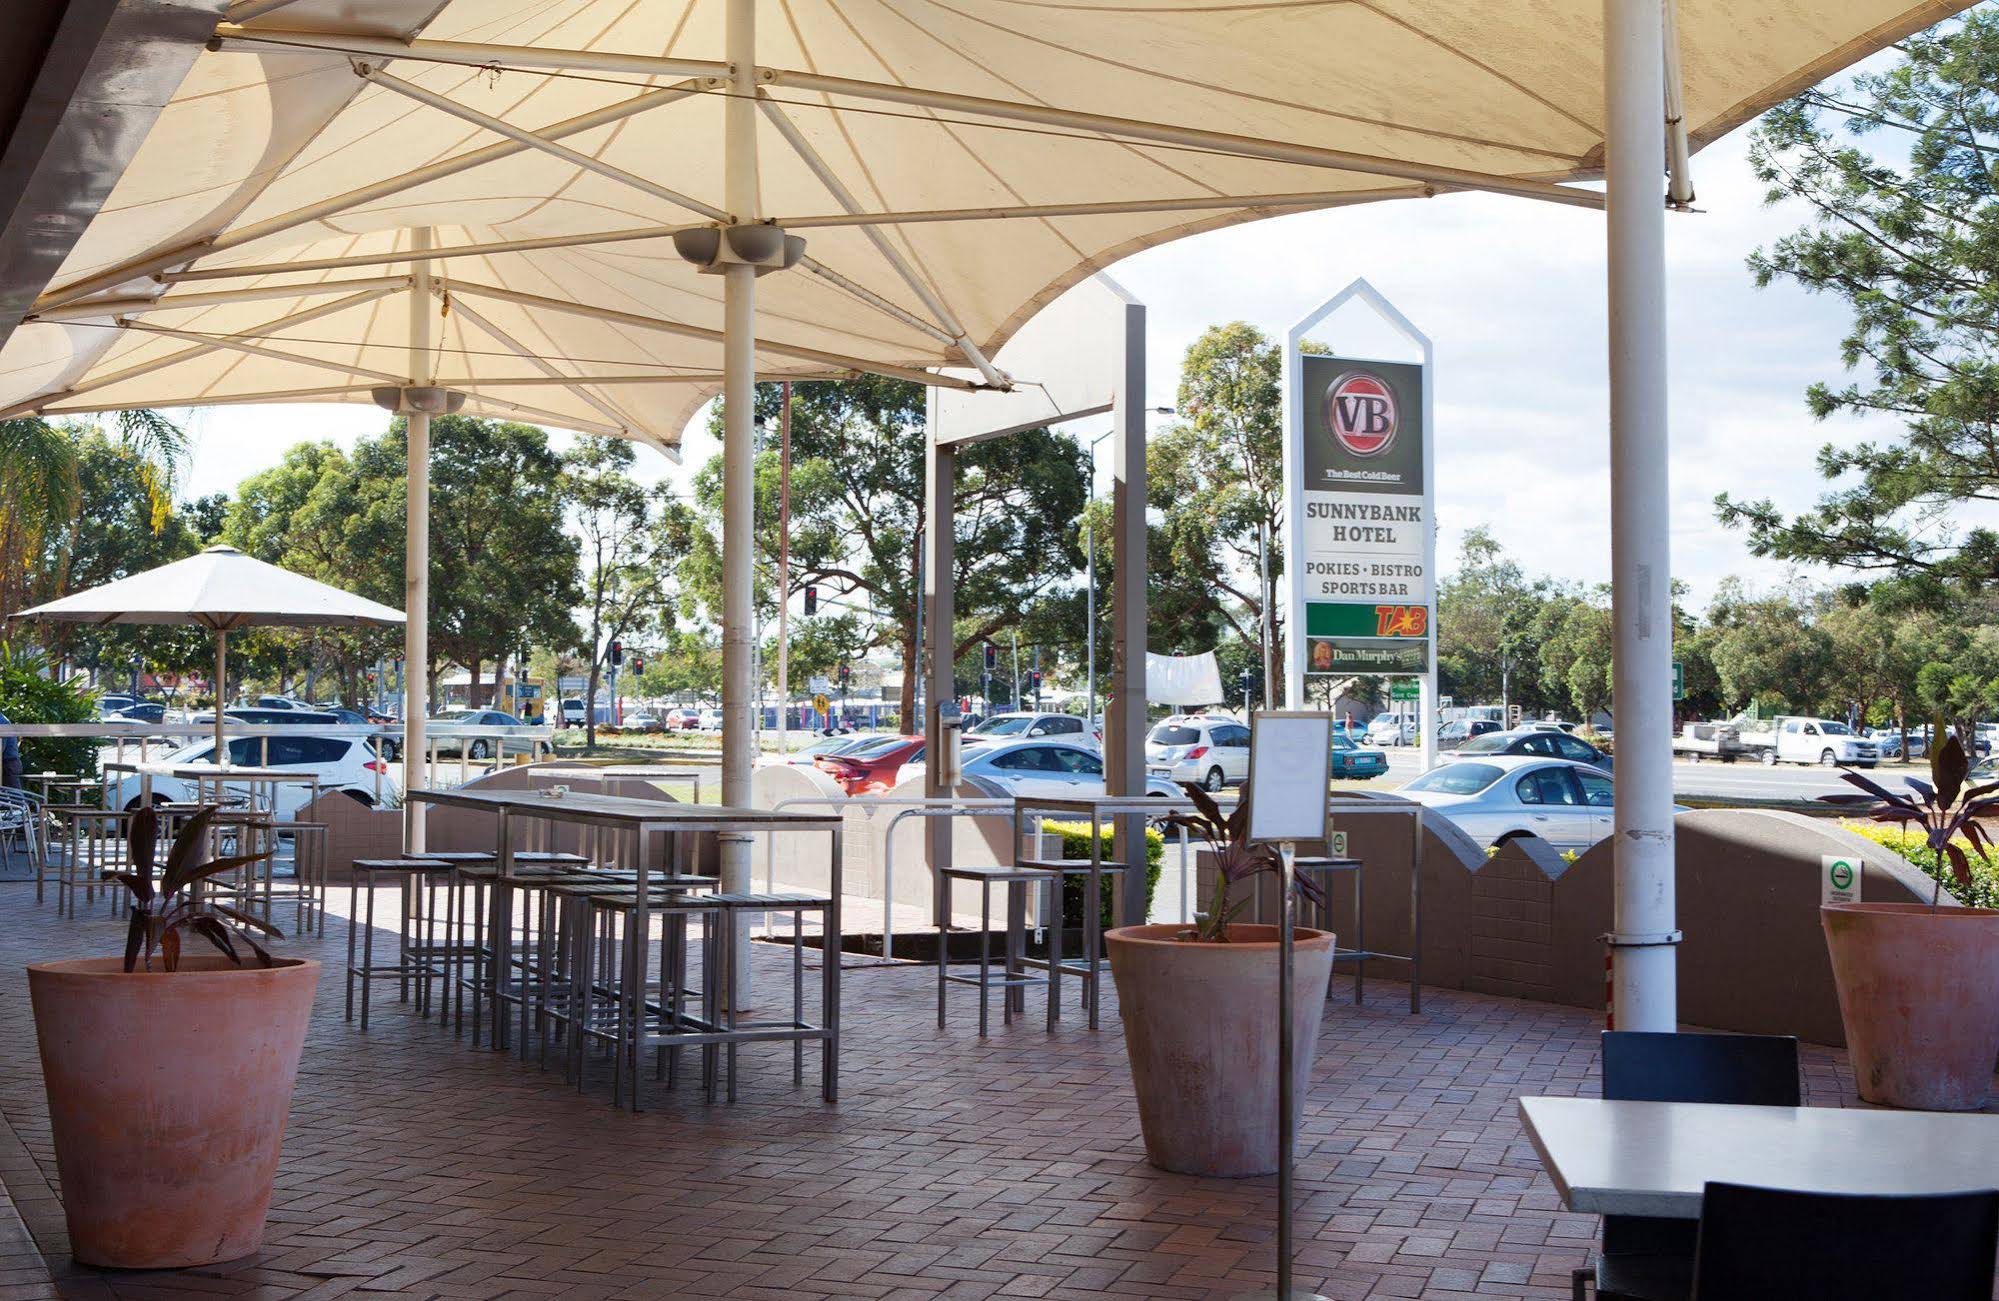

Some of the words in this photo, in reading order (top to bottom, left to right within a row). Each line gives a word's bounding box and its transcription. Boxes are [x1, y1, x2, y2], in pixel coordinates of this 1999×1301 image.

[1335, 396, 1391, 434] VB
[1326, 469, 1343, 478] The
[1343, 470, 1361, 479] Best
[1361, 470, 1380, 480] Cold
[1381, 472, 1401, 481] Beer
[1306, 502, 1422, 522] SUNNYBANK
[1333, 525, 1397, 543] HOTEL
[1306, 562, 1360, 576] POKIES
[1371, 564, 1423, 577] BISTRO
[1321, 581, 1377, 595] SPORTS
[1378, 583, 1408, 595] BAR
[1375, 605, 1428, 637] TAB
[1333, 648, 1355, 661] Dan
[1355, 649, 1402, 664] Murphy's
